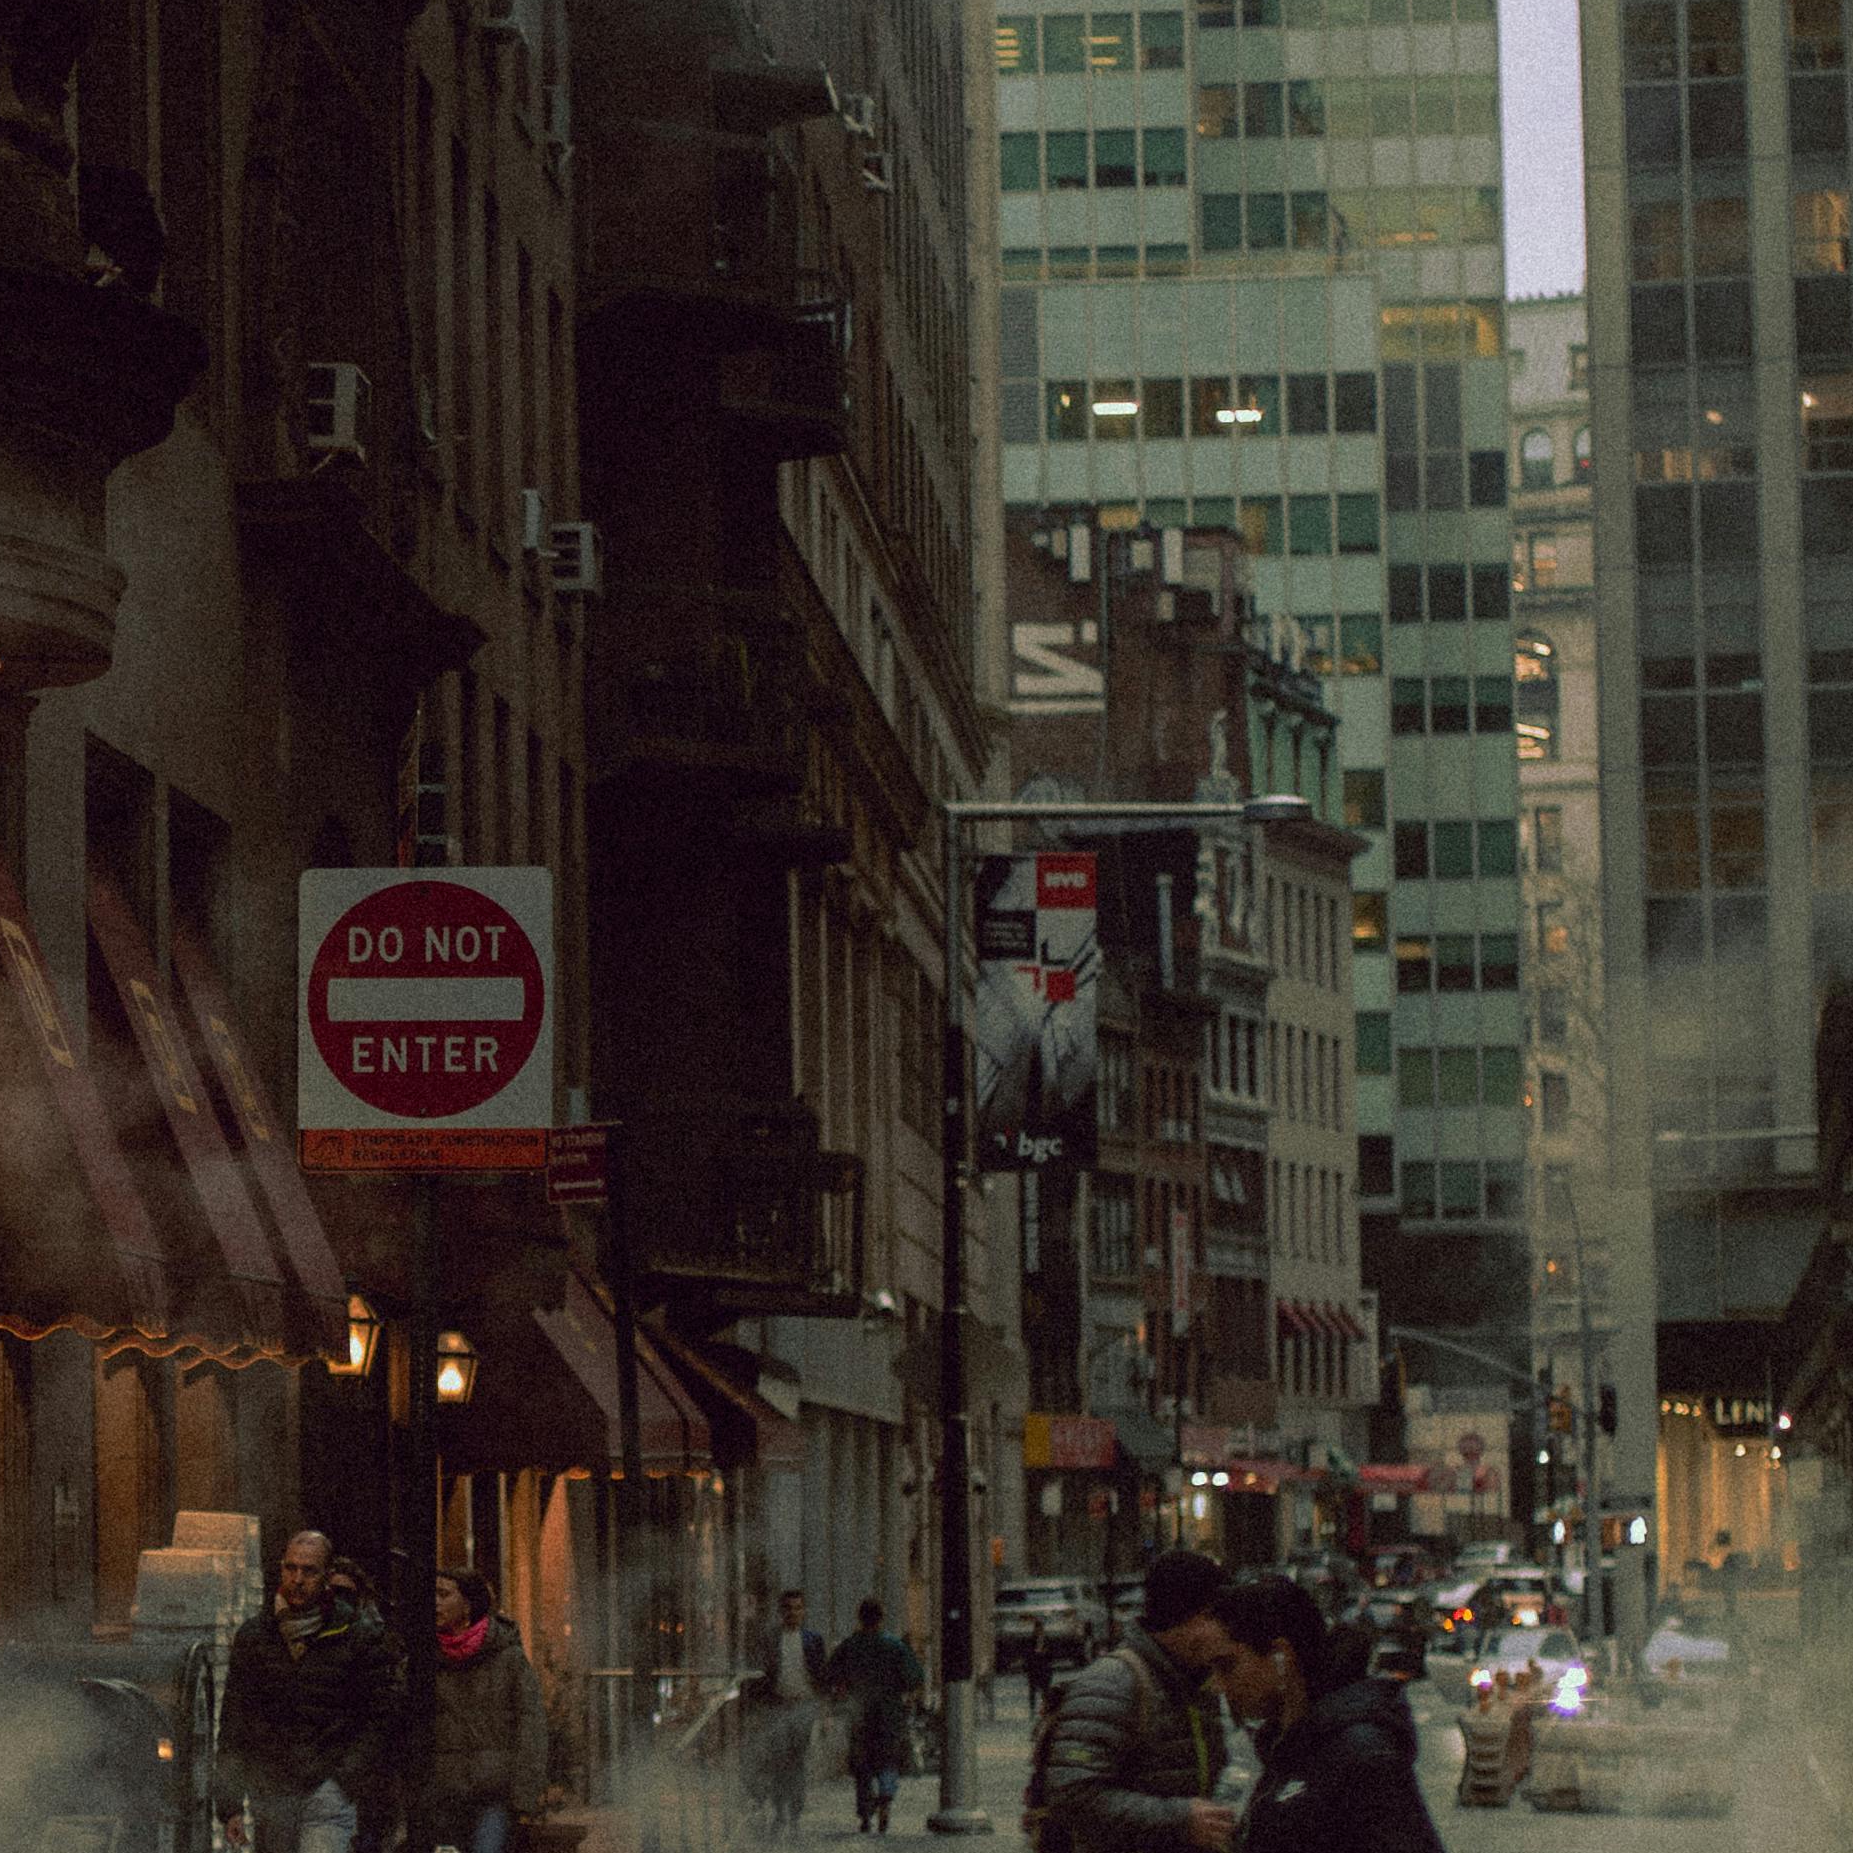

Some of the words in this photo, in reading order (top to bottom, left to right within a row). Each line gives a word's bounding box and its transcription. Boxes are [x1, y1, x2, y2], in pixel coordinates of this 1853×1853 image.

[348, 926, 403, 963] DO
[425, 926, 507, 963] NOT
[353, 1038, 499, 1074] ENTER
[1017, 1130, 1063, 1164] bgc
